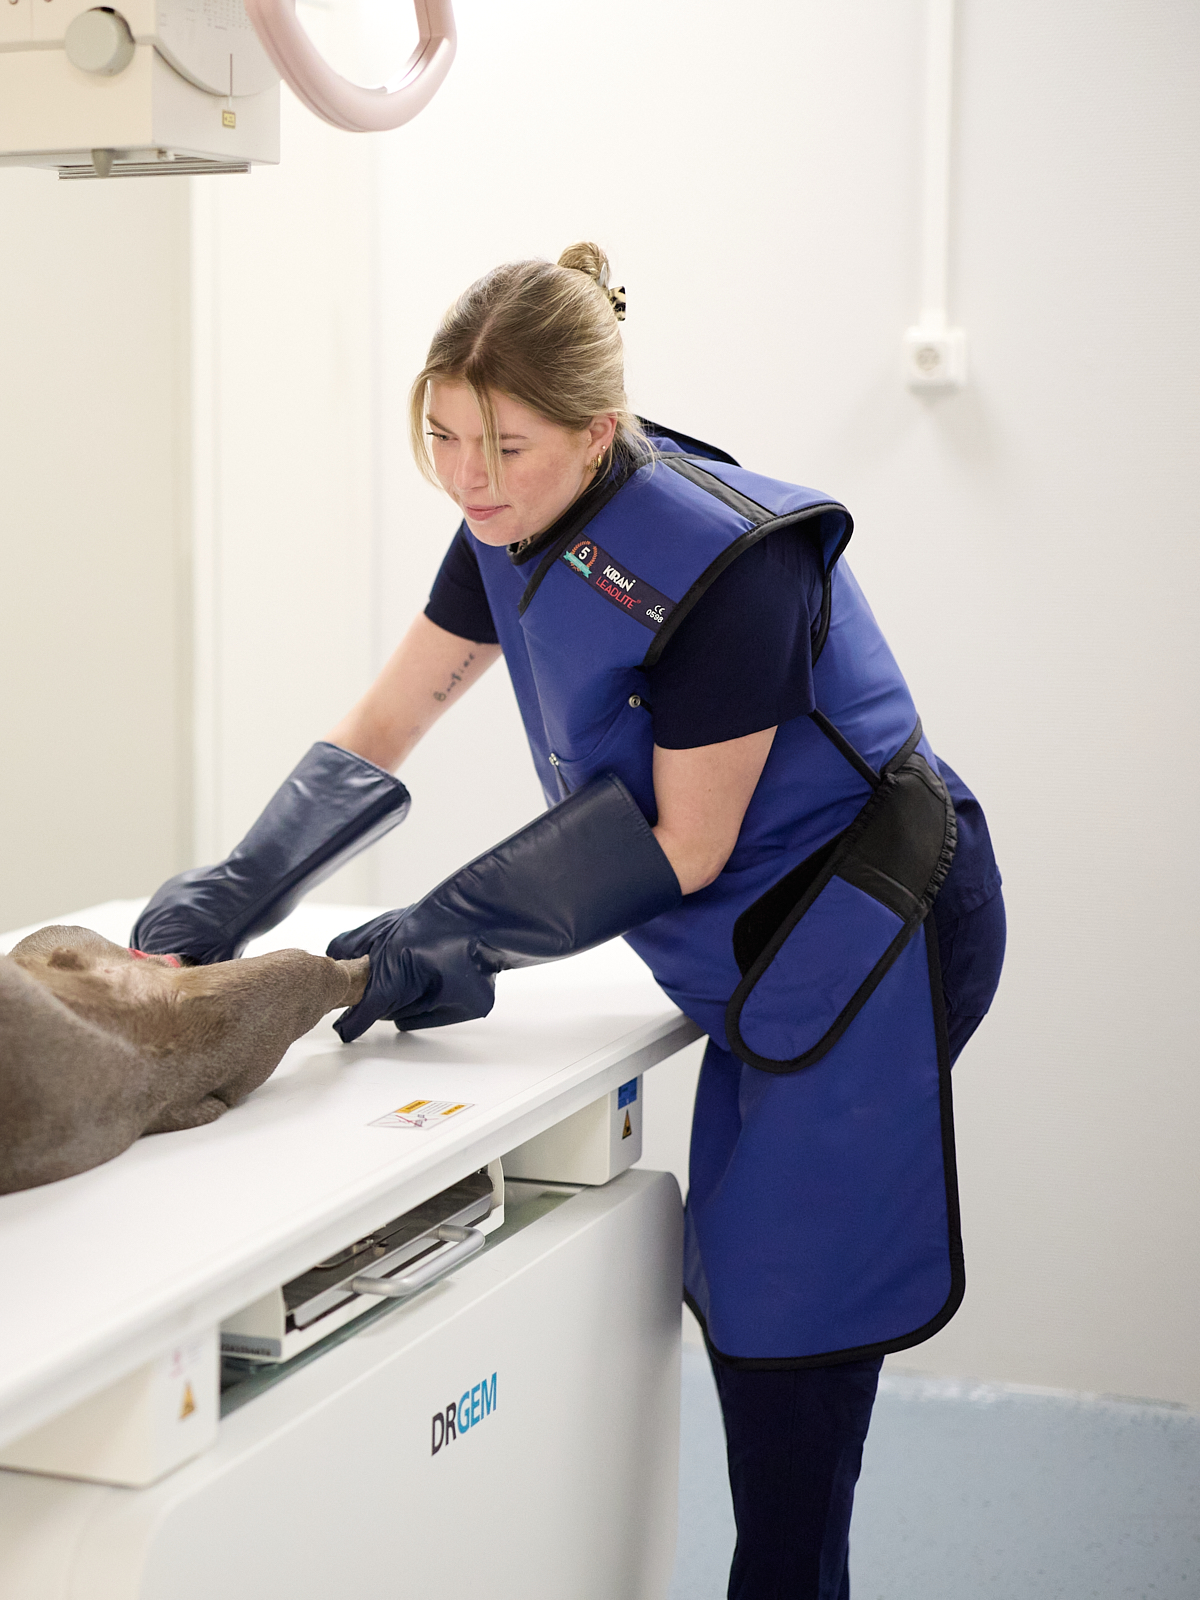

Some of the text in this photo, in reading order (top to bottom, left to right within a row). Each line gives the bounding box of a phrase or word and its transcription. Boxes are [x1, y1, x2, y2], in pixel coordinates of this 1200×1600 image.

[578, 546, 591, 560] 5
[645, 608, 664, 623] 0598
[431, 1371, 497, 1457] DRGEM
